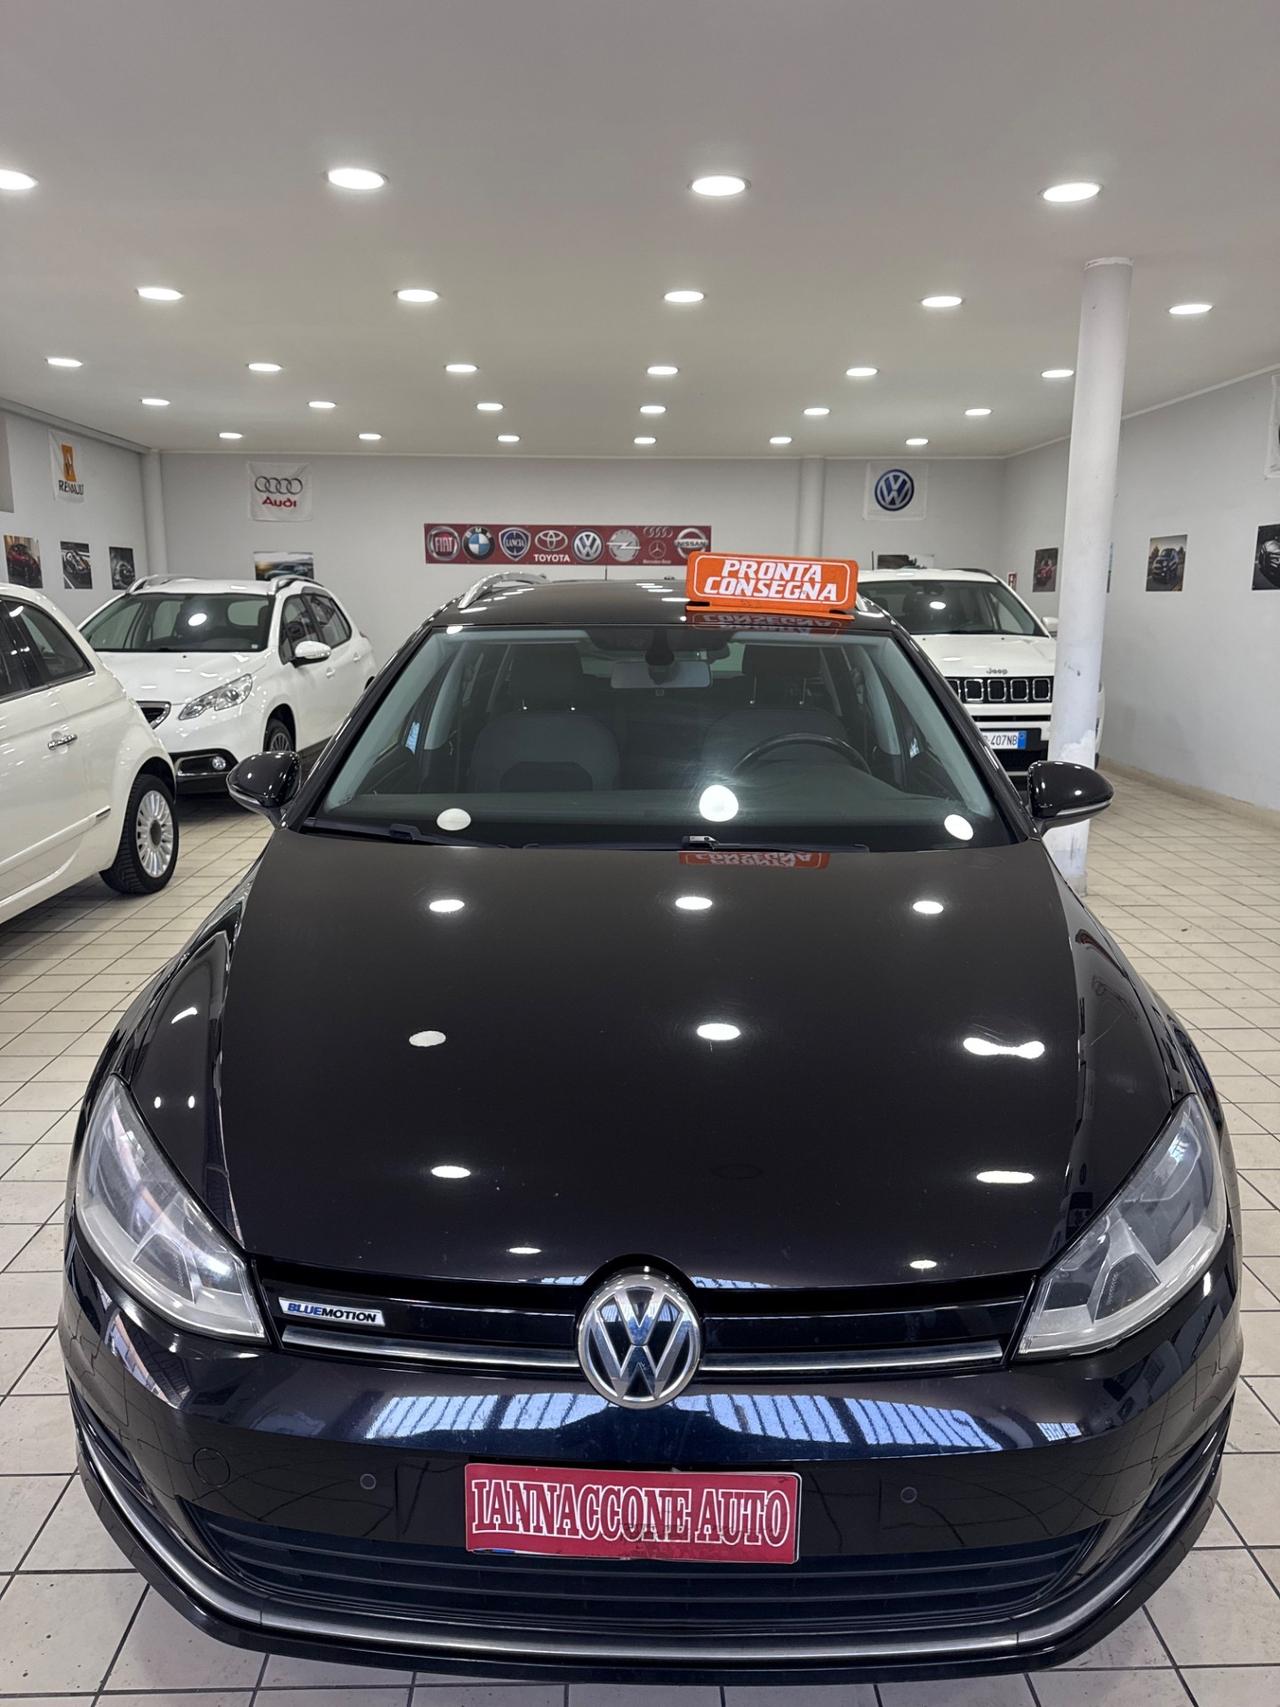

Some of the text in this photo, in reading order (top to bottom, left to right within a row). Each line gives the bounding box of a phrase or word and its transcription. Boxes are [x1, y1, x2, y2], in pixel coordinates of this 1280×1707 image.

[262, 496, 297, 507] Audi
[435, 537, 453, 552] FIAT
[533, 554, 570, 562] TOYOTA
[722, 560, 822, 582] PRONTA
[703, 577, 837, 600] CONSEGNA
[287, 1303, 377, 1322] BLUEMOTION
[472, 1479, 791, 1548] IANNACCONE AUTO
